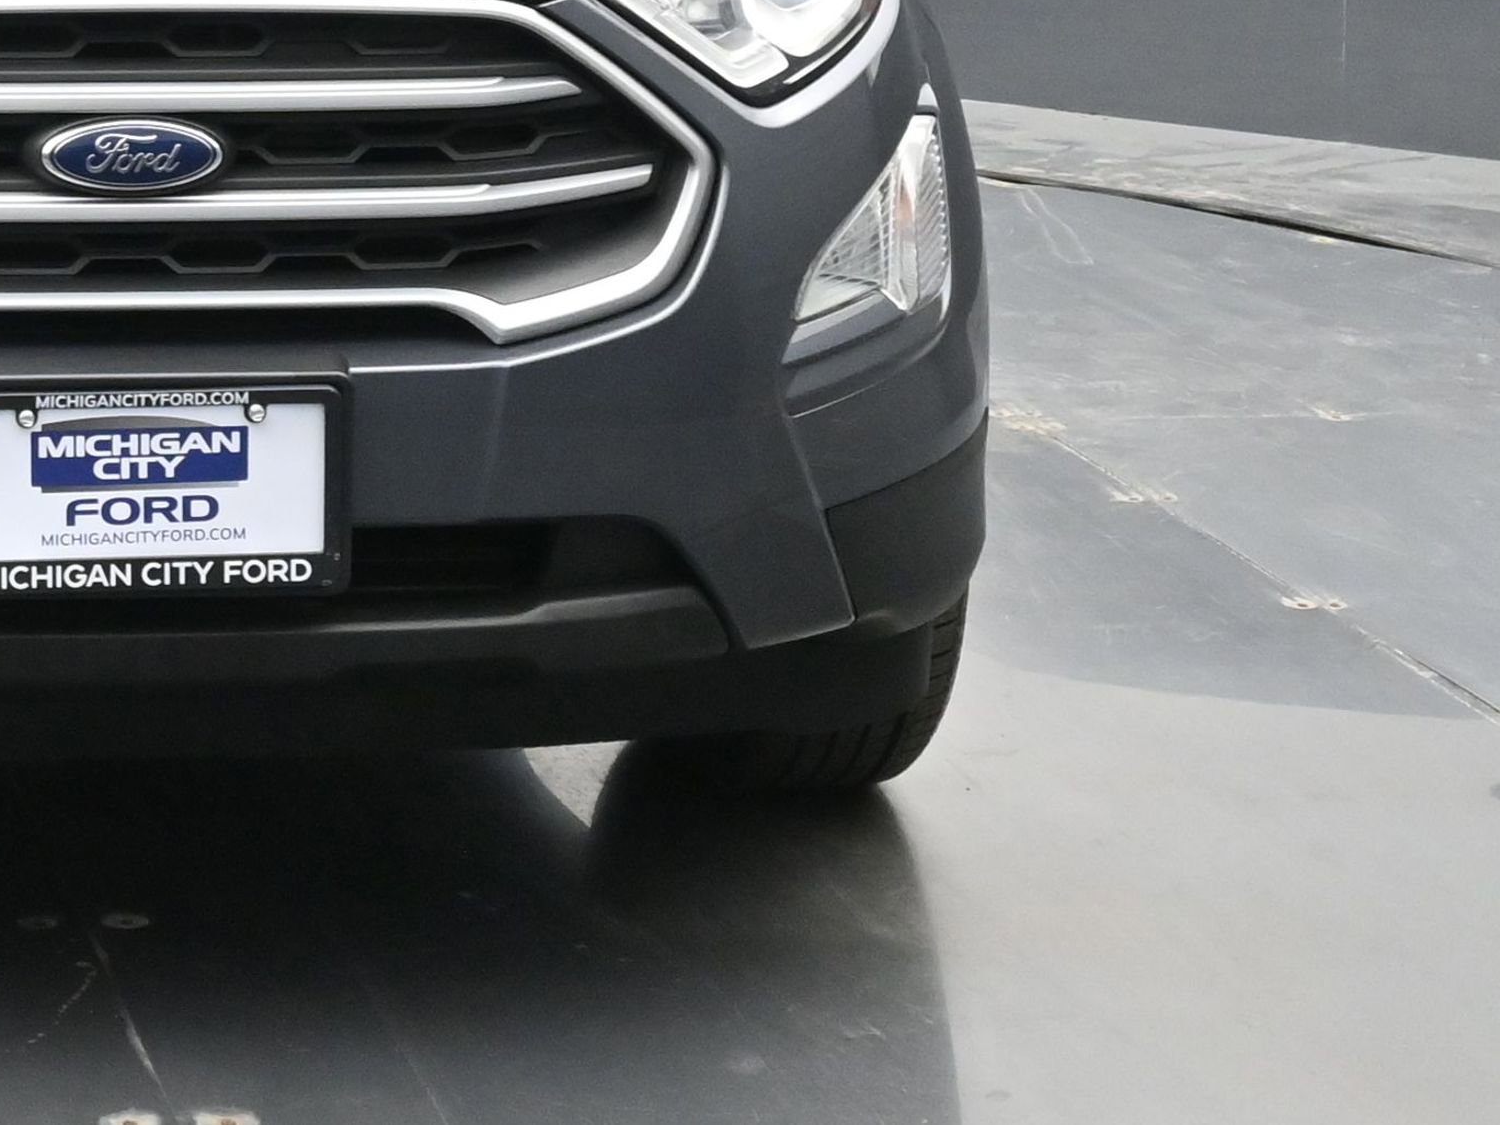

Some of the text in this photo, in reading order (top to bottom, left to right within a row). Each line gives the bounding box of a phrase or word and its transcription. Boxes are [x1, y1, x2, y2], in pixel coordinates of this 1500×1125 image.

[85, 133, 182, 173] Ford
[35, 391, 249, 409] MICHIGANCITYFORD.COM
[37, 431, 241, 459] MICHIGAN
[93, 455, 185, 480] CITY
[66, 495, 219, 526] FORD
[41, 527, 246, 546] MICHIGANCITYFORD.COM
[141, 561, 214, 587] CITY
[223, 558, 313, 584] FORD
